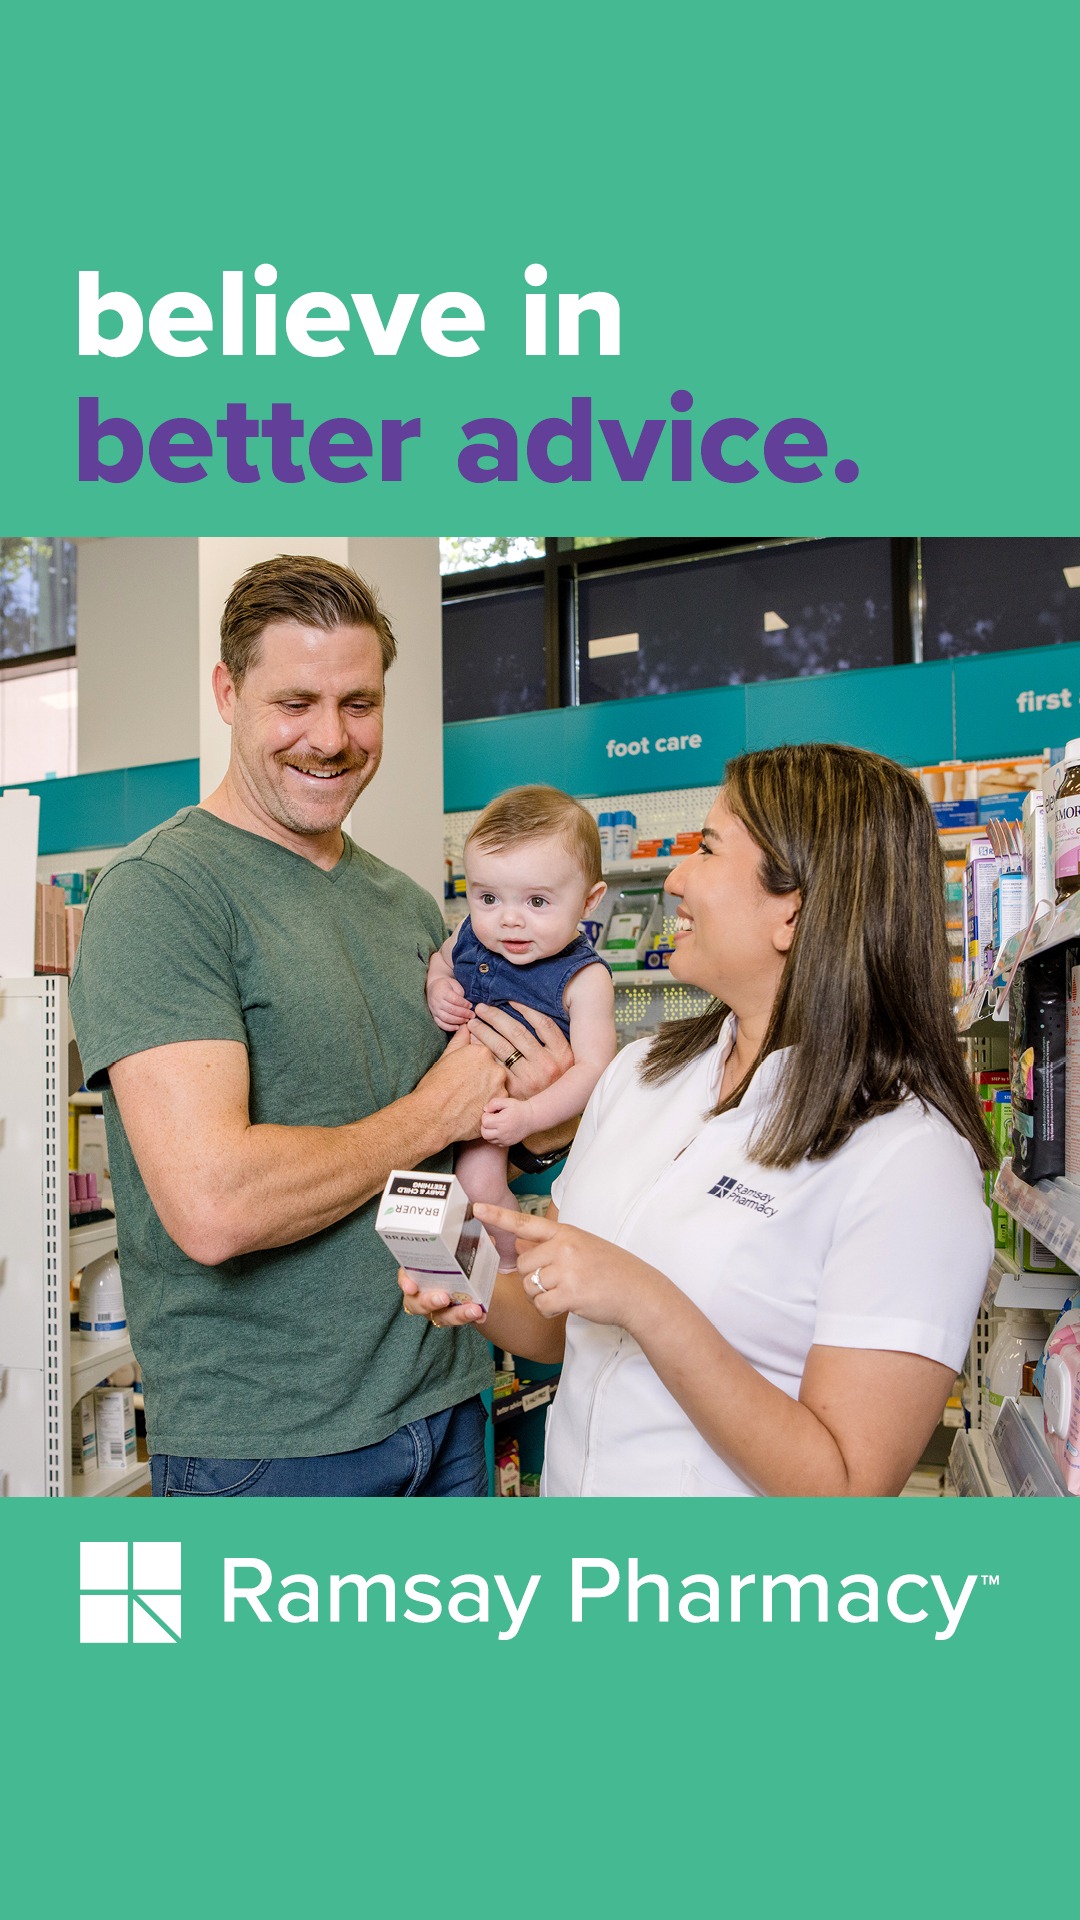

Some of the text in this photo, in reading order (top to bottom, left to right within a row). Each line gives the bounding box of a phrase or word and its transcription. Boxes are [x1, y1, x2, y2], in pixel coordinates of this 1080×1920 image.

[1016, 688, 1072, 713] first
[606, 734, 702, 758] foot care
[397, 1186, 419, 1195] CHILD
[412, 1181, 447, 1191] TEETHING
[425, 1188, 446, 1197] BABY
[734, 1183, 775, 1205] Ramsay
[395, 1204, 440, 1217] BRAUER
[727, 1192, 779, 1219] Pharmacy
[385, 1234, 430, 1243] BRAUER
